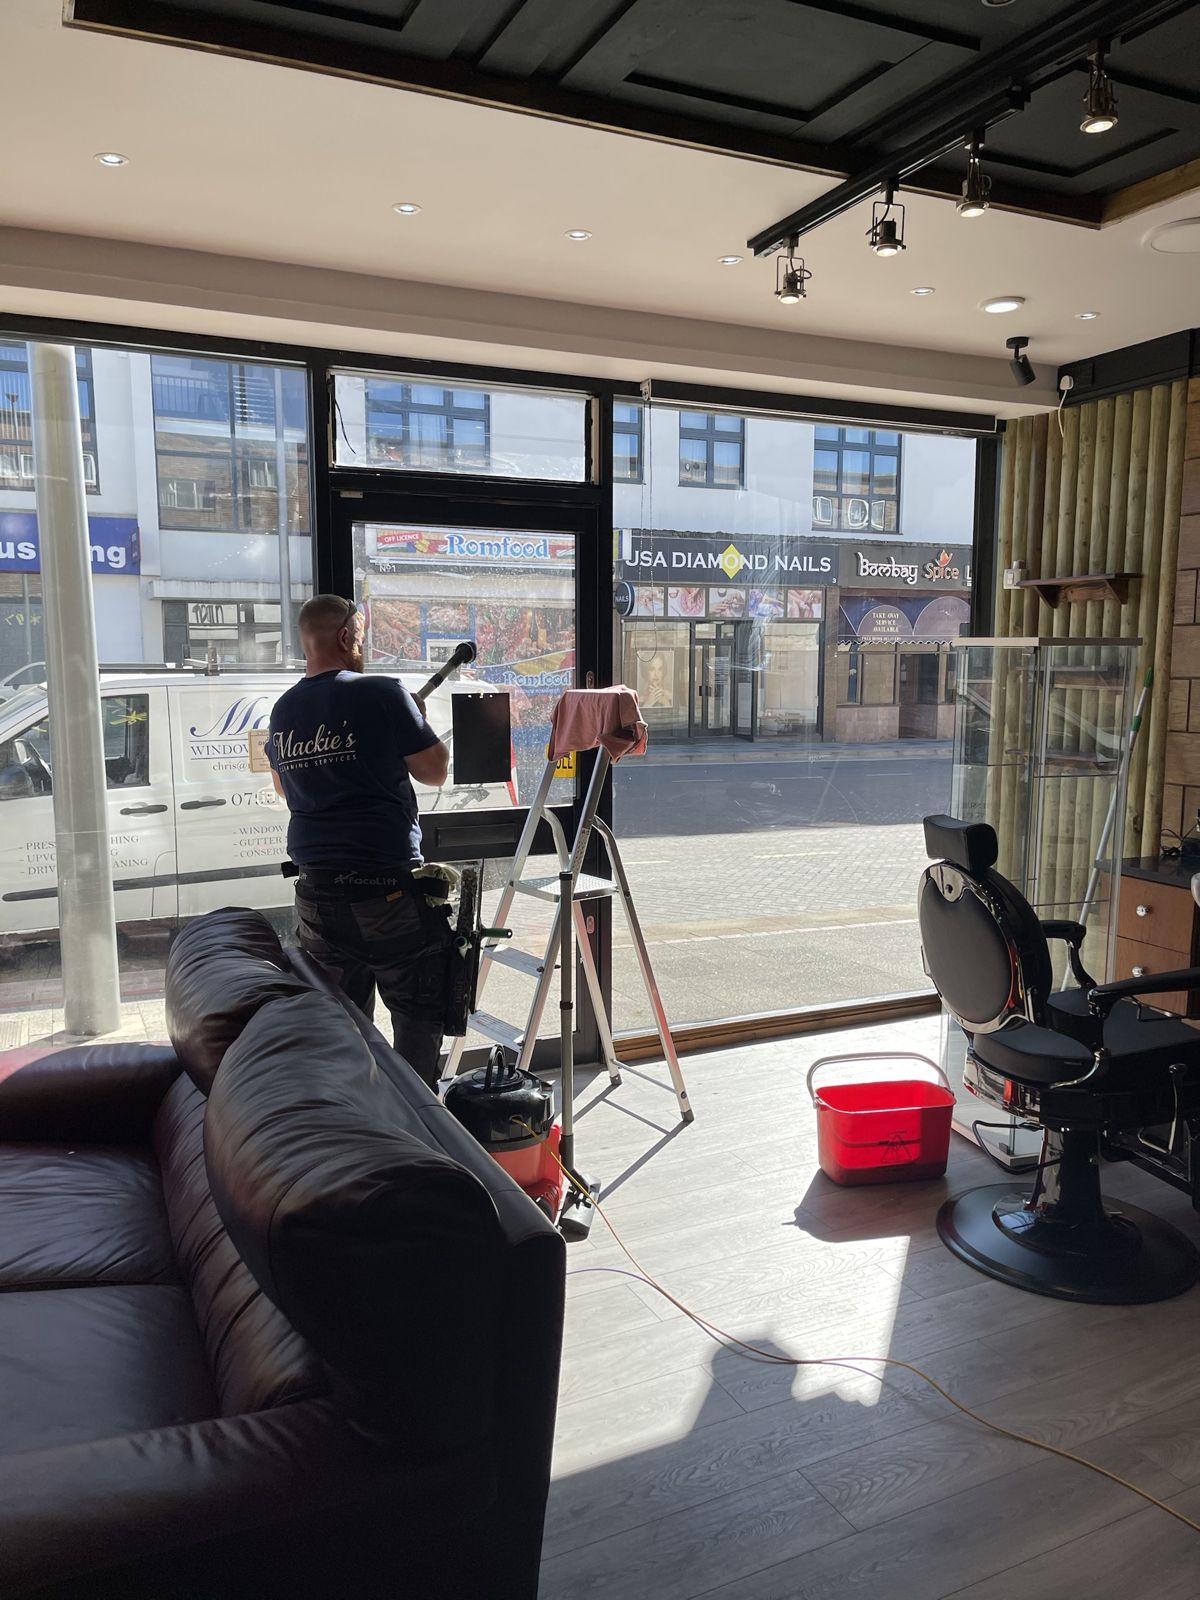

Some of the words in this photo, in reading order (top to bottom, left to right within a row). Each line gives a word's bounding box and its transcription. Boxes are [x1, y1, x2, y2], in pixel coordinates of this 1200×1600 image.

[384, 535, 396, 543] OFF
[396, 533, 420, 542] LICENCE
[444, 532, 551, 560] Romfood
[90, 545, 126, 568] ng
[672, 552, 769, 570] DIAMOND
[774, 556, 831, 572] NAILS
[856, 551, 919, 584] Bombay
[923, 562, 960, 583] Spice
[272, 720, 356, 760] Mackie's
[190, 744, 249, 756] WINDO
[212, 760, 250, 772] chris@
[314, 754, 357, 767] SERVICES
[239, 825, 284, 835] WINDOW
[26, 841, 56, 850] PRES
[110, 835, 139, 844] HING
[239, 837, 282, 847] GUTTER
[240, 848, 287, 858] CONSERV
[28, 865, 56, 875] DRIV
[112, 858, 148, 868] ANING
